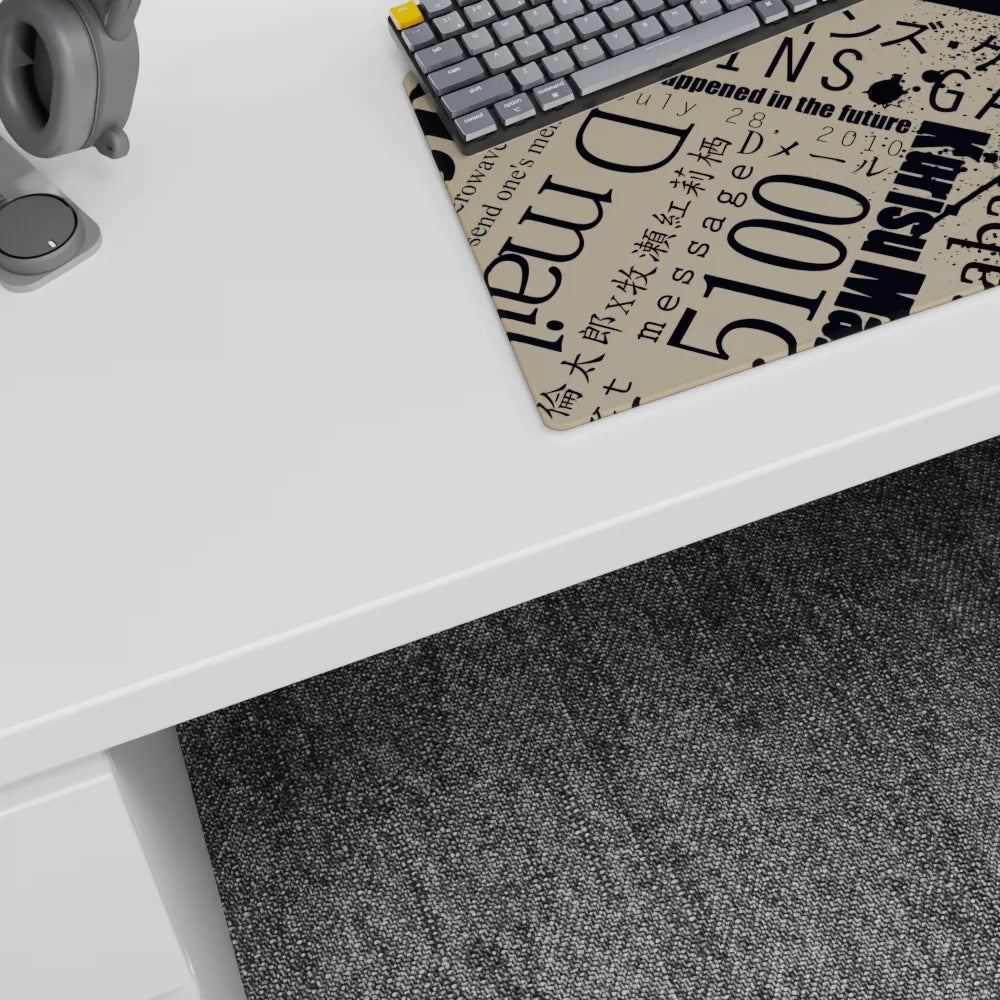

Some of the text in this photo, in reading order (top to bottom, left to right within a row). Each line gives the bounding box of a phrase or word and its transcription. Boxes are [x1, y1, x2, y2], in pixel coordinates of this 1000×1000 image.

[503, 97, 522, 109] option
[537, 80, 565, 95] command
[463, 111, 484, 124] control
[618, 91, 697, 117] uly
[816, 125, 904, 157] 2010
[766, 89, 793, 110] in
[792, 96, 835, 119] the
[837, 104, 912, 134] future
[496, 157, 535, 202] one's
[637, 164, 754, 344] message
[666, 174, 871, 361] 5100
